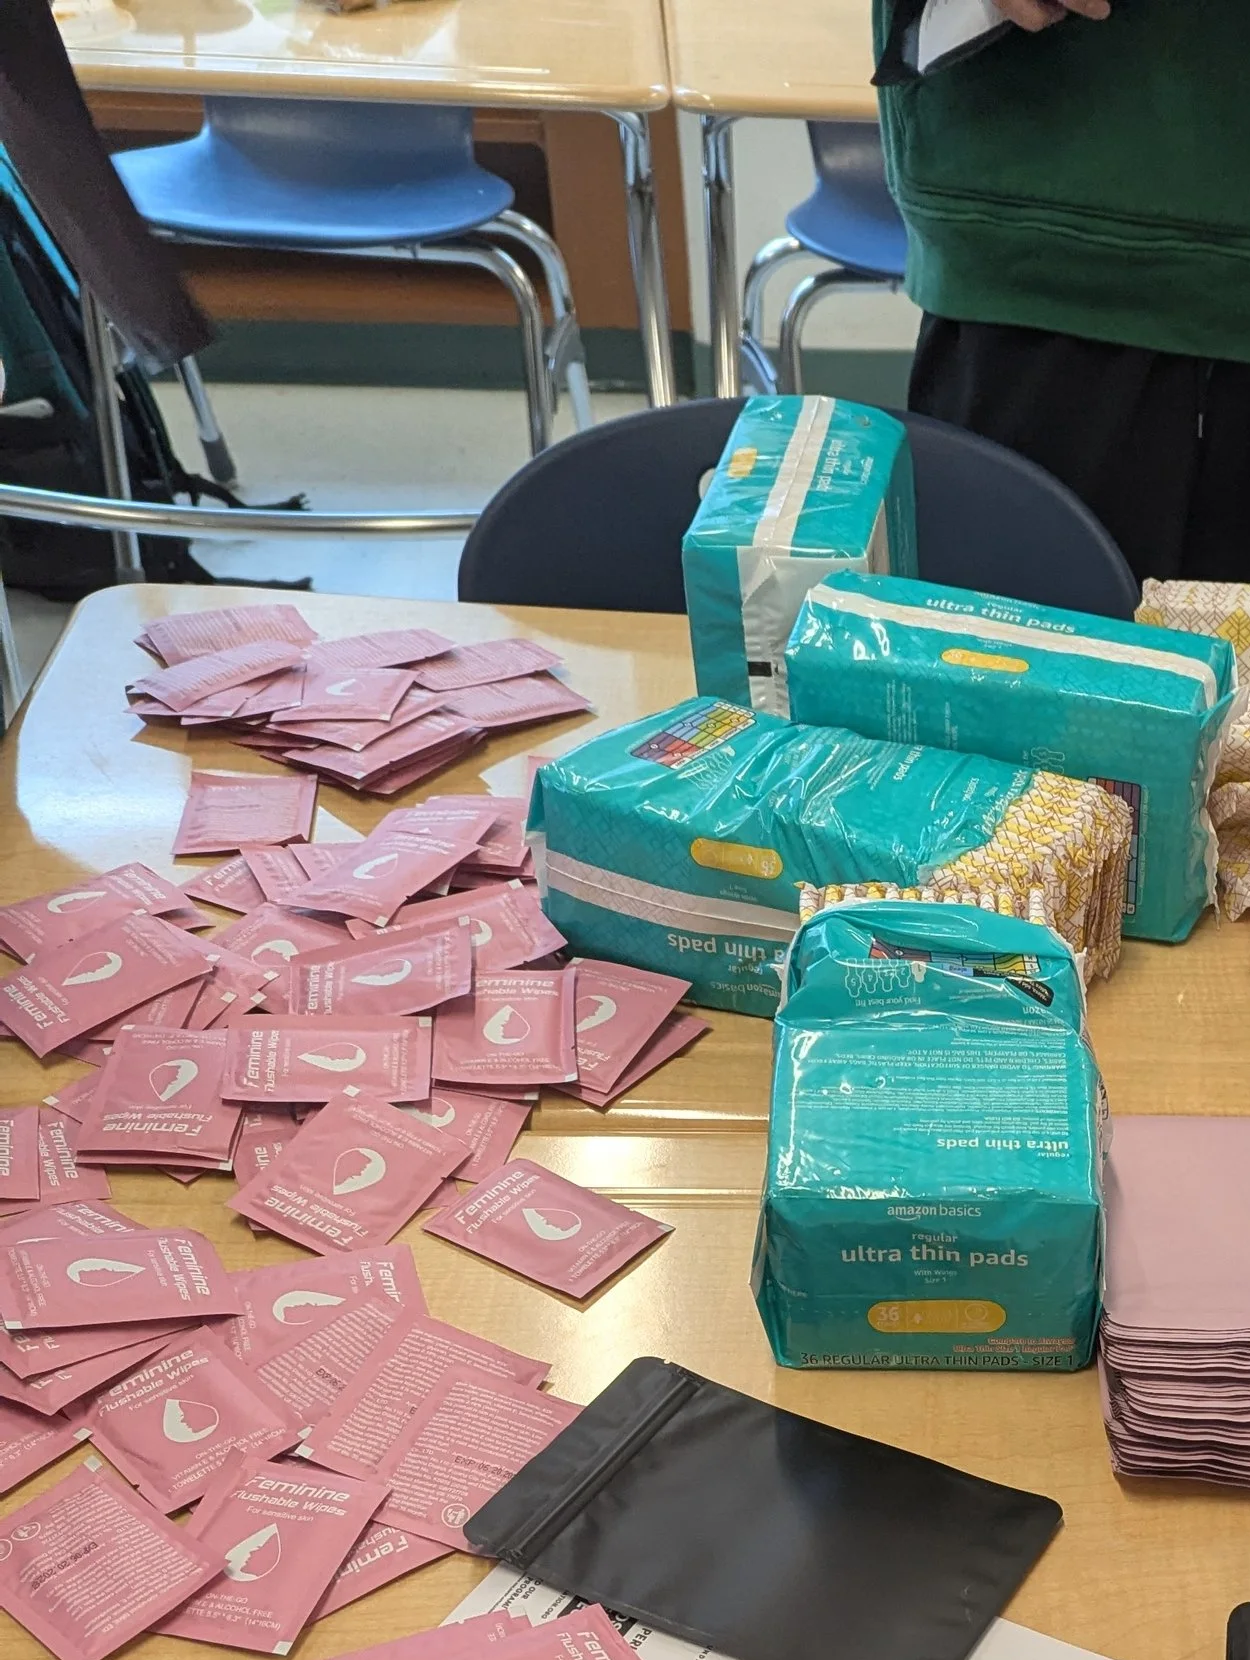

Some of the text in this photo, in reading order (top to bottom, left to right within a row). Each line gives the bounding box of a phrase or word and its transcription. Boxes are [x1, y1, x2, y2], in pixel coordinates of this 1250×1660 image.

[926, 598, 974, 613] ultra
[981, 607, 1021, 623] thin
[1026, 617, 1075, 634] pads
[667, 934, 766, 961] thin pads
[4, 985, 56, 1030] Feminine
[244, 1030, 264, 1089] Feminine
[102, 1122, 204, 1137] Feminine
[937, 1137, 1069, 1150] ultra thin pads
[48, 1121, 79, 1179] Feminine
[453, 1168, 525, 1226] Feminine
[887, 1204, 982, 1217] amazon basics
[264, 1197, 354, 1246] Feminine
[465, 1192, 511, 1235] Flushable
[911, 1232, 958, 1243] regular
[174, 1237, 210, 1296] Feminine
[841, 1244, 1029, 1267] ultra thin pads
[878, 1307, 899, 1322] 36
[801, 1353, 1073, 1367] 36 REGULAR ULTRA THIN PADS SIZE 1
[99, 1356, 209, 1417] Flushable Wipes
[229, 1489, 348, 1517] Flushable Wipes
[245, 1475, 350, 1503] Feminine
[246, 1505, 314, 1523] For sensitive skin
